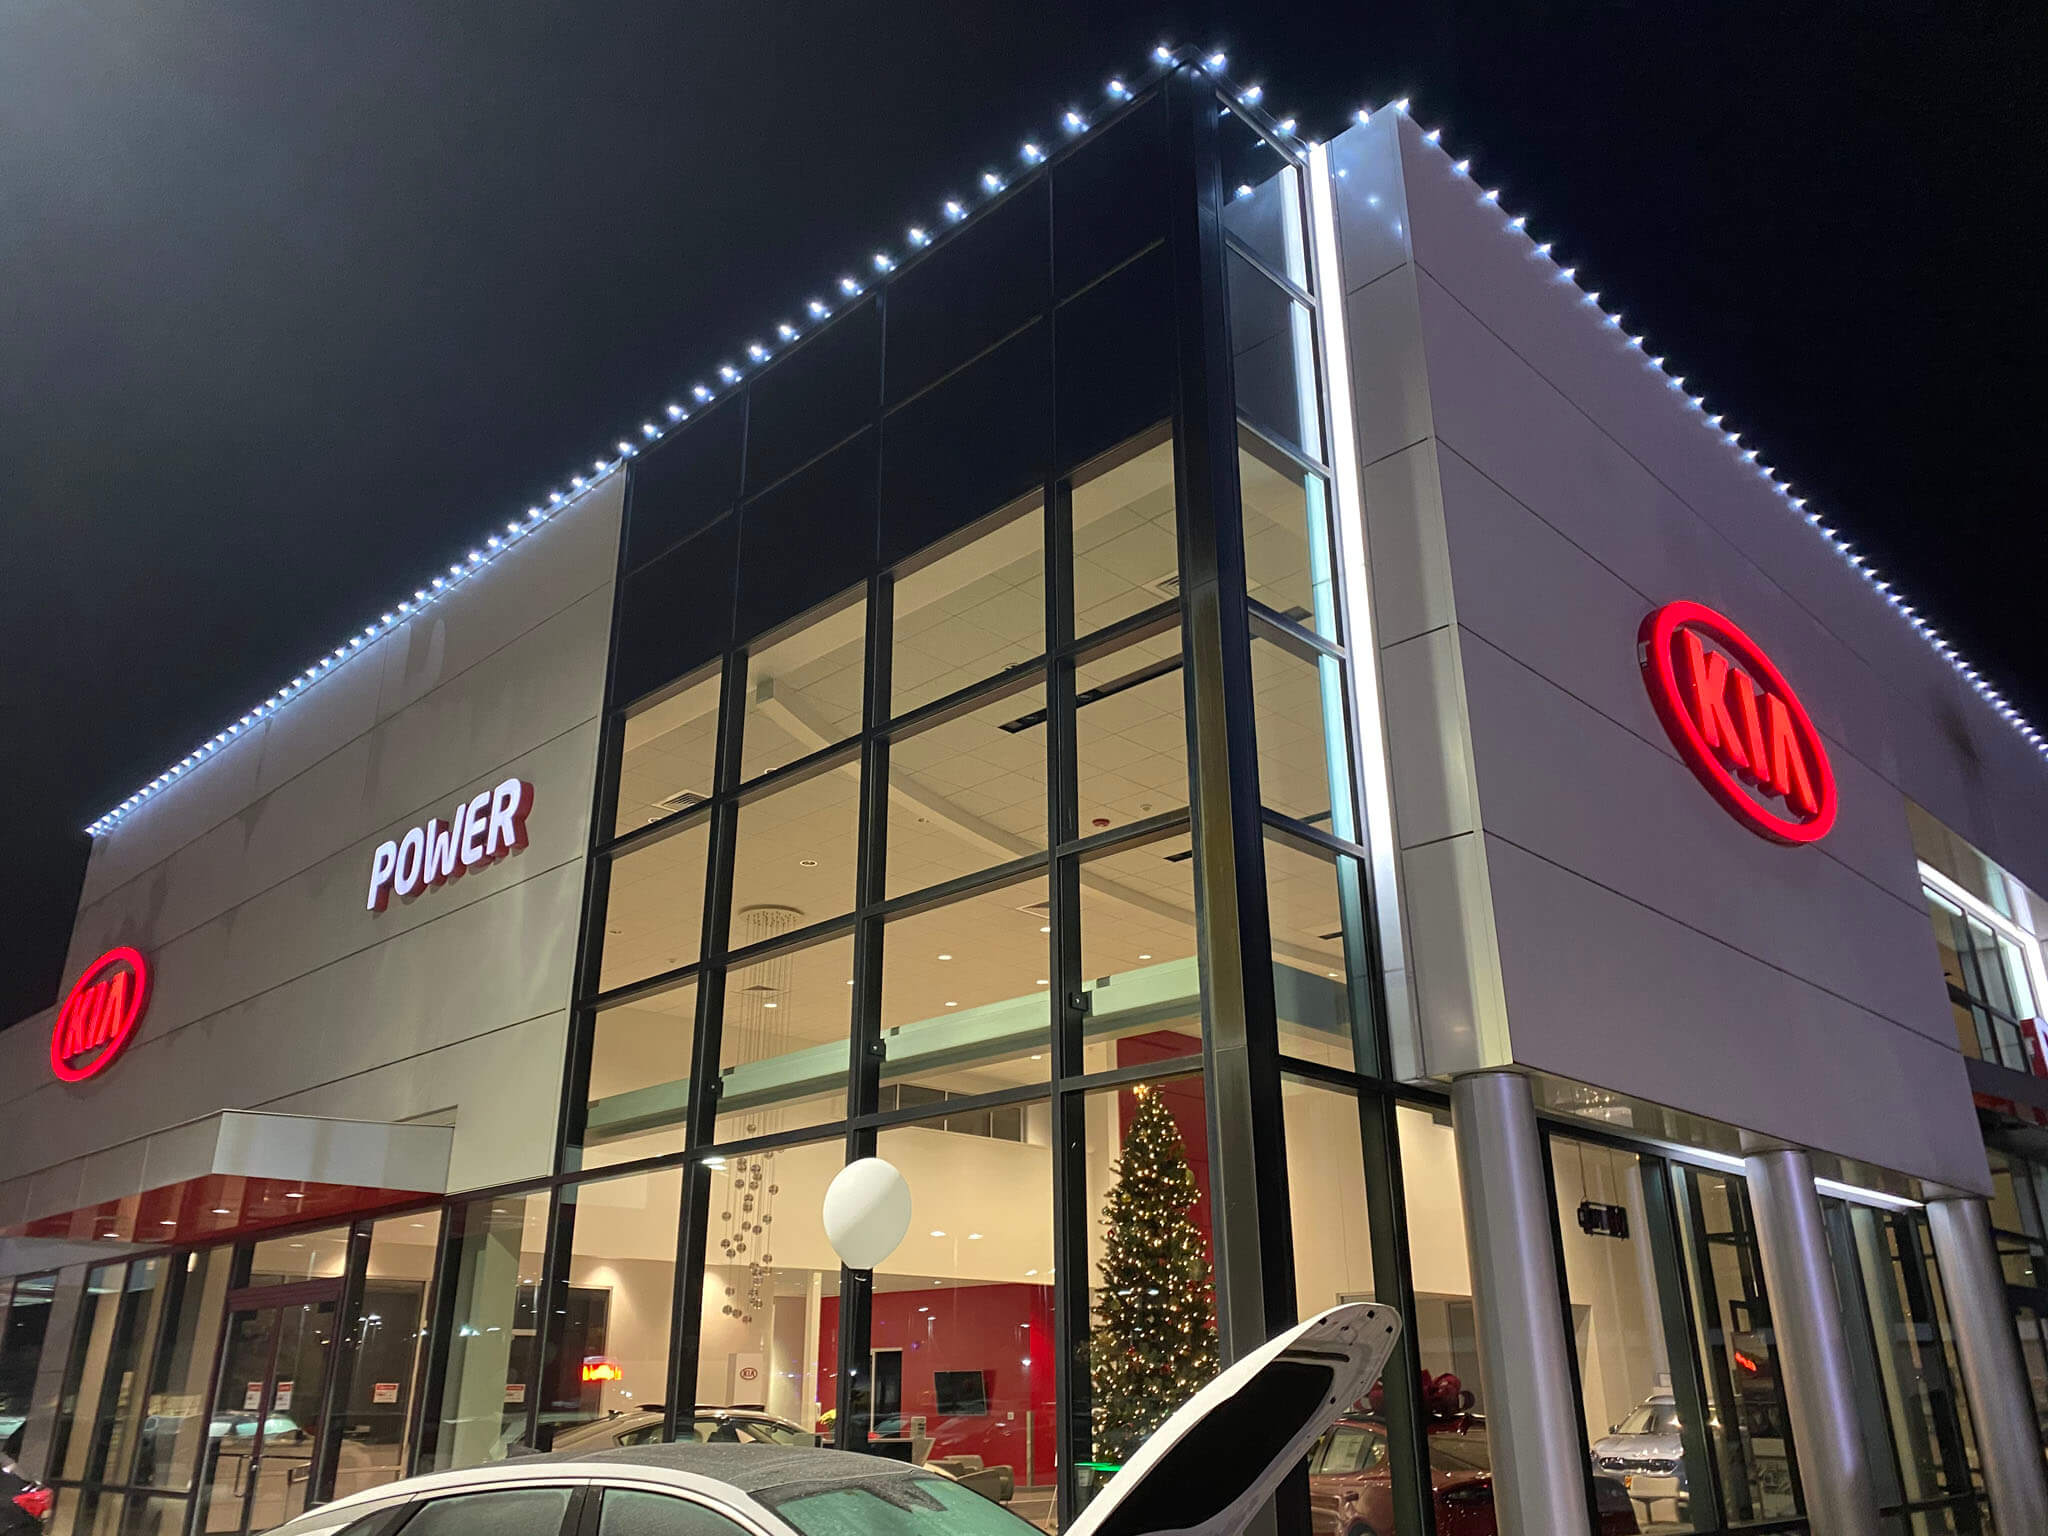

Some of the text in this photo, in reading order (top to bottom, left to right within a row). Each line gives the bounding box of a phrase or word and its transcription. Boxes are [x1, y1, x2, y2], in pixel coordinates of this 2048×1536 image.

[1679, 624, 1820, 818] KIA
[366, 777, 525, 912] POWER
[60, 969, 129, 1061] KIA
